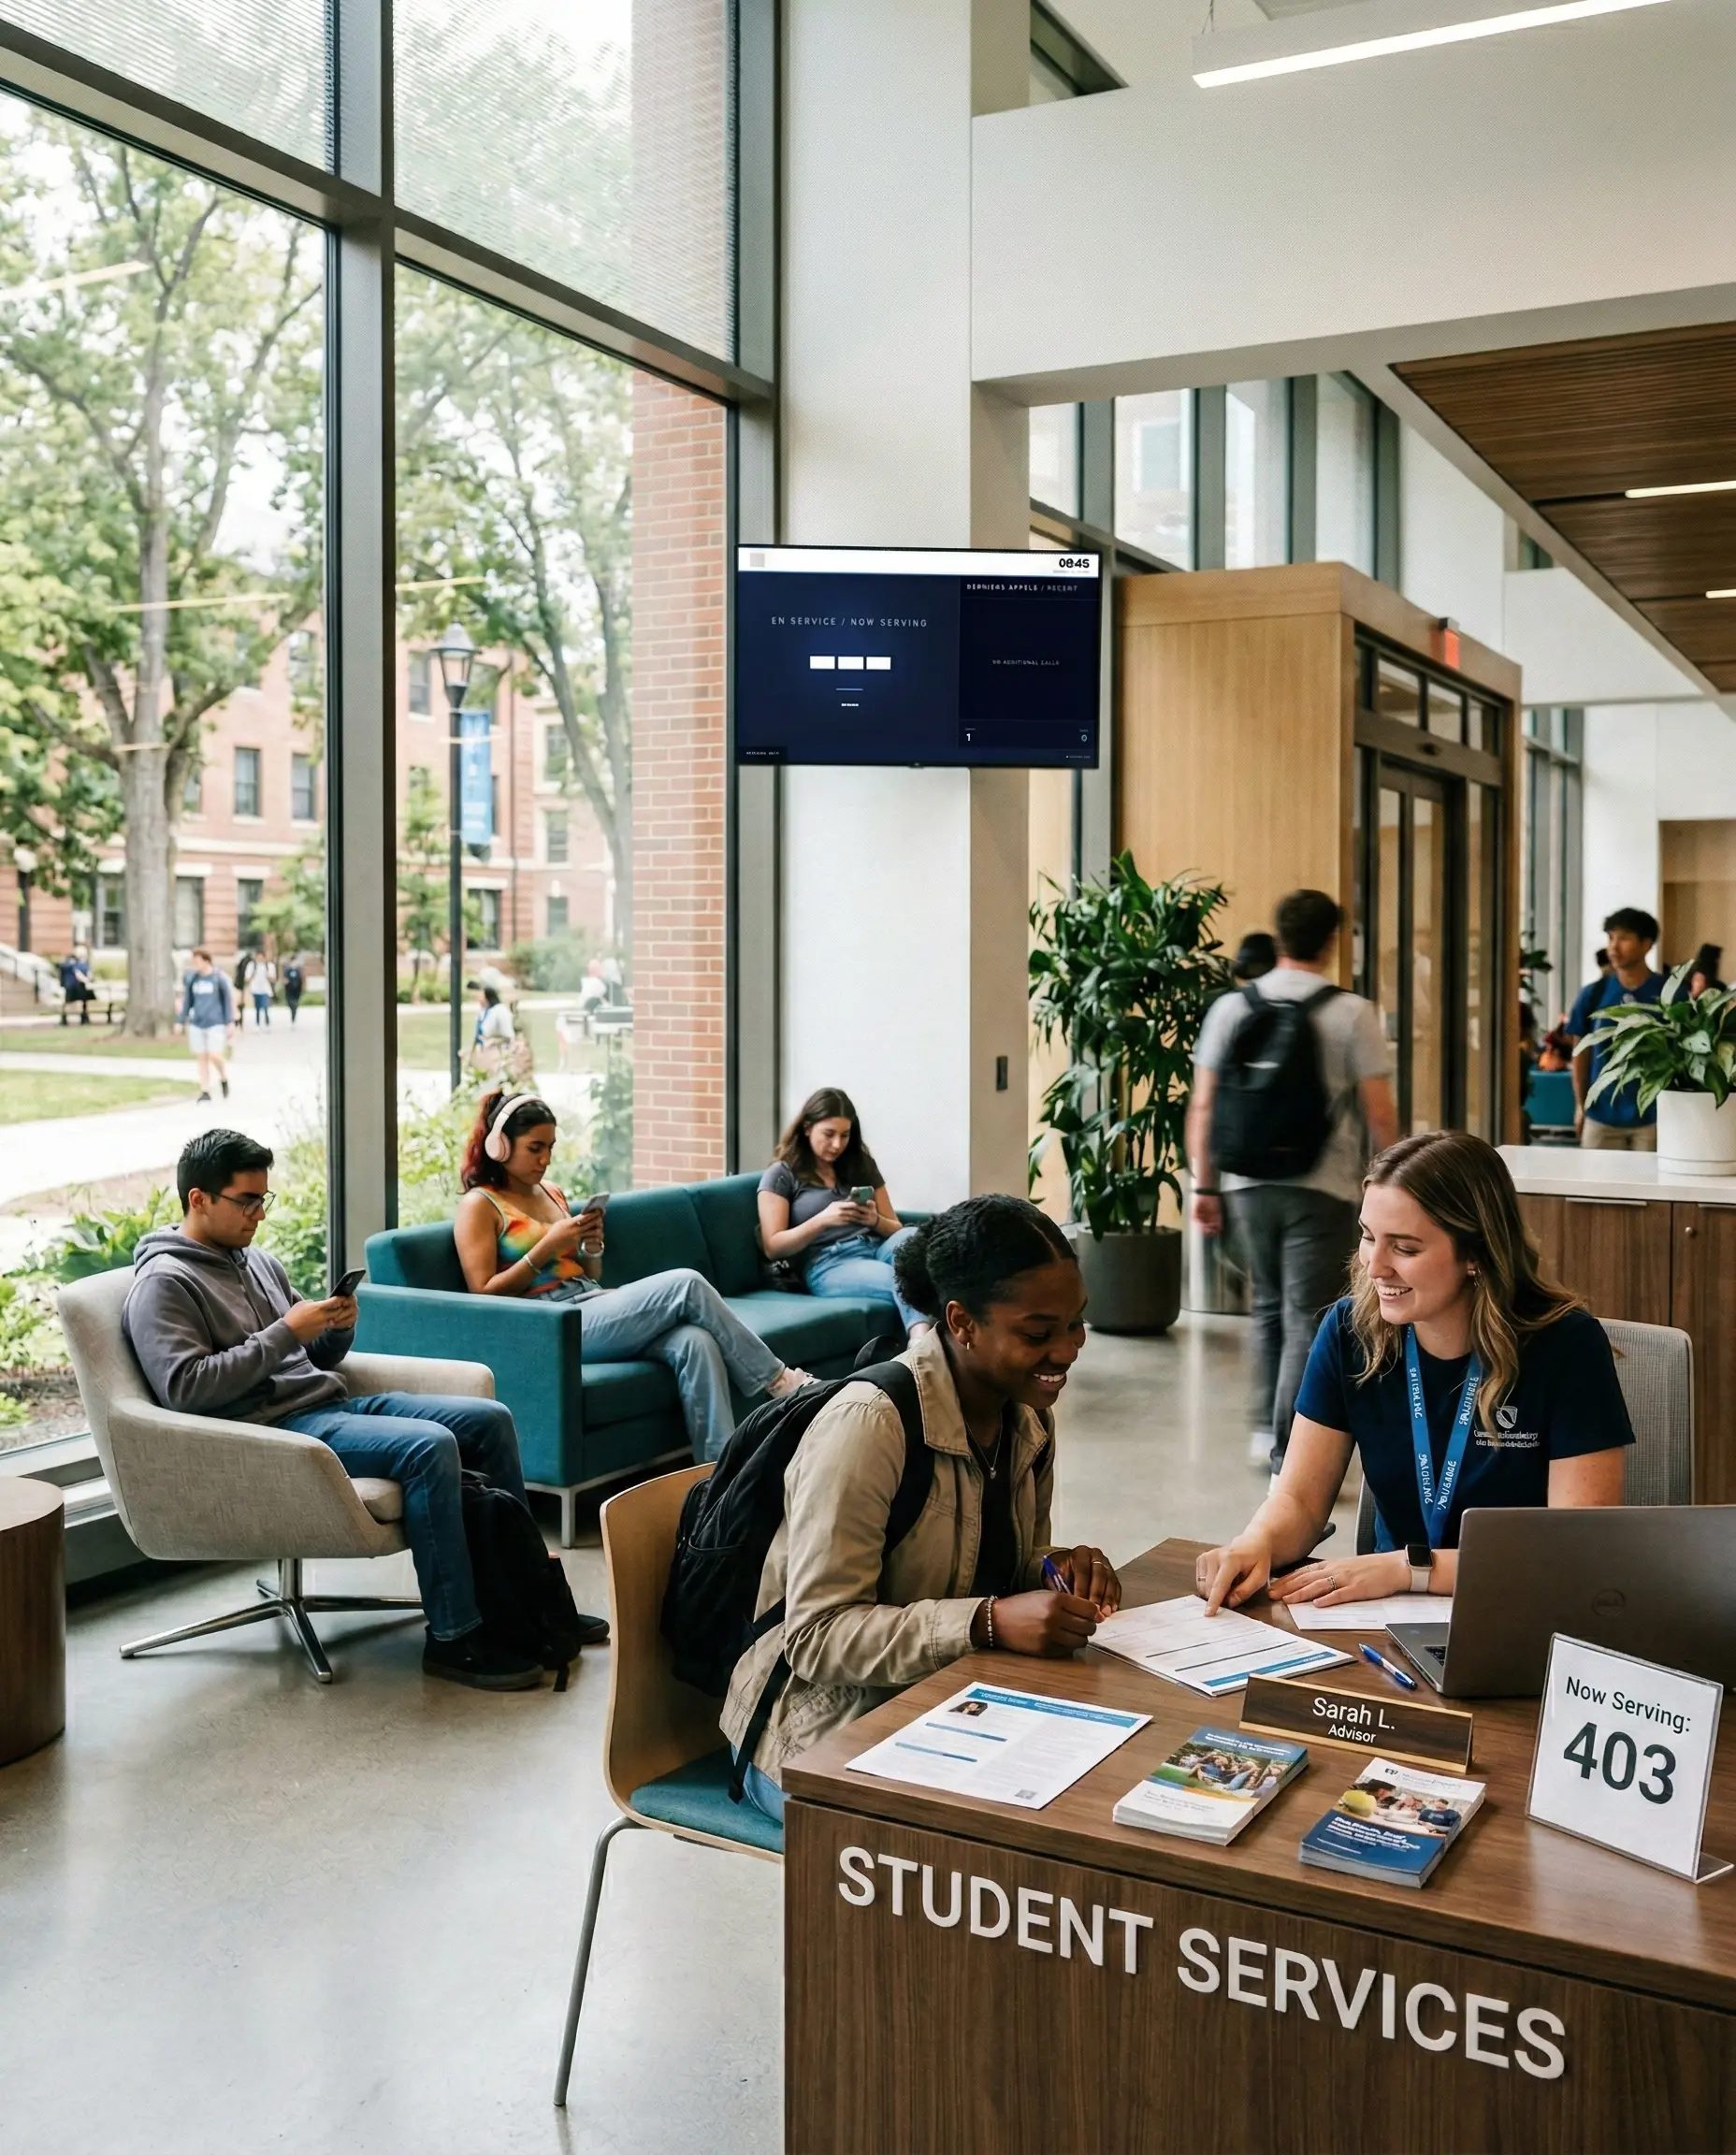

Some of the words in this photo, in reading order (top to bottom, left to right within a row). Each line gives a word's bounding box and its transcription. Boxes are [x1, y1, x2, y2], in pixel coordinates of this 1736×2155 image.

[771, 616, 785, 625] EN
[790, 616, 836, 626] SERVICE
[850, 617, 875, 627] NOW
[880, 618, 927, 628] SERVING
[1312, 1697, 1371, 1725] Sarah
[1378, 1712, 1396, 1730] L.
[1566, 1676, 1607, 1705] Now
[1612, 1691, 1691, 1735] Serving:
[1328, 1724, 1377, 1743] Advisor
[1563, 1721, 1676, 1805] 403
[838, 1845, 1154, 1975] STUDENT
[1177, 1928, 1566, 2080] SERVICES
